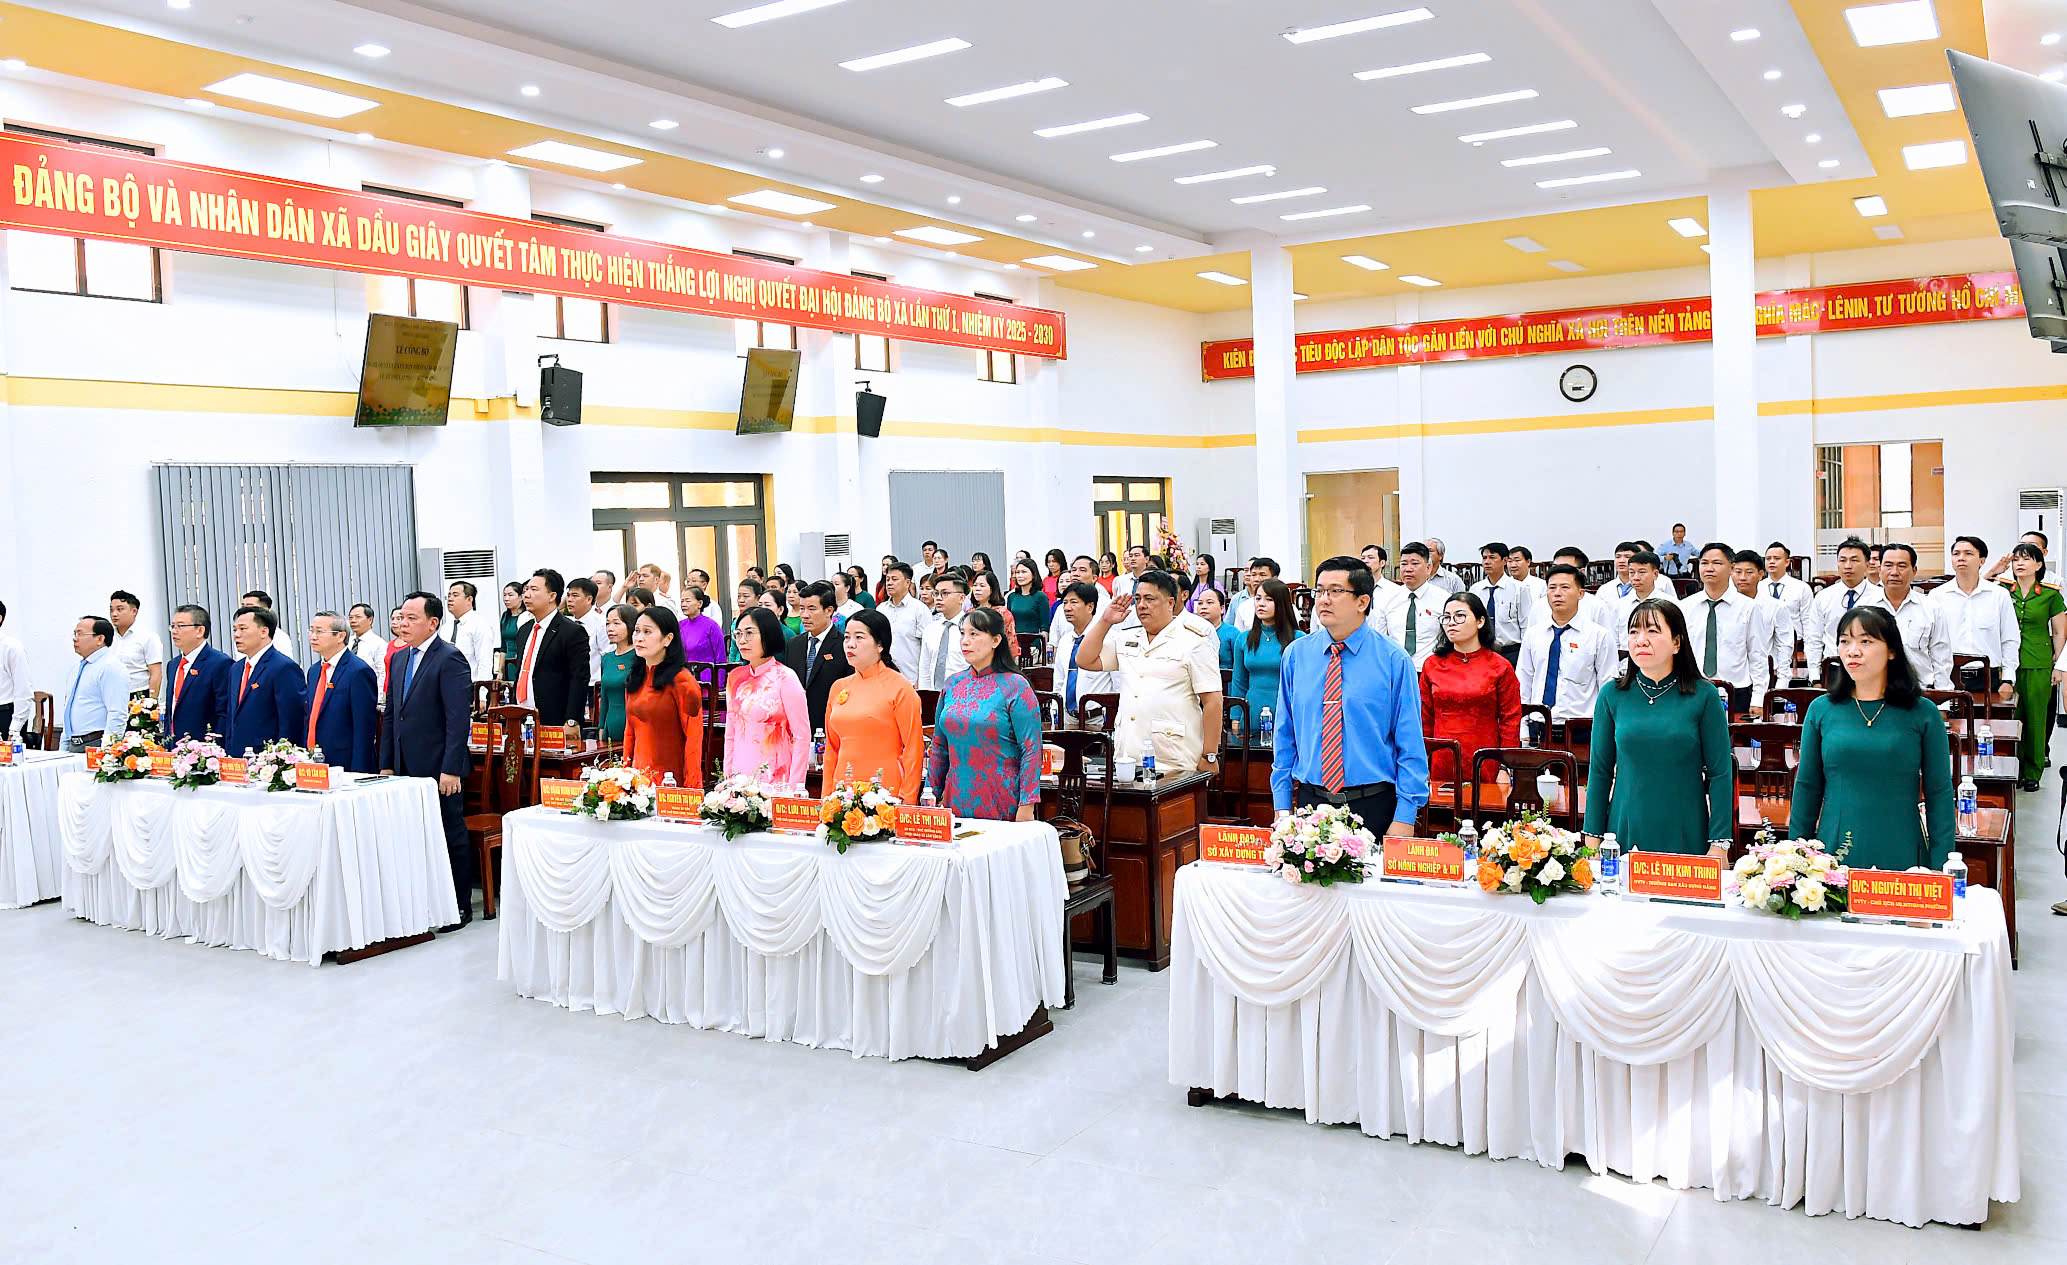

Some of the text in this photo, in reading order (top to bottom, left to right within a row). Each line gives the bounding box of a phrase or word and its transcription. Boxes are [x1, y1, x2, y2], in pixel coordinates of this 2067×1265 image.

[13, 155, 95, 214] ĐẢNG
[103, 172, 140, 228] BỘ
[147, 180, 183, 226] VÀ
[189, 189, 260, 236] NHÂN
[266, 198, 315, 244] DÂN
[321, 206, 351, 249] XÃ
[357, 208, 400, 255] DẦU
[406, 221, 451, 262] GIÂY
[457, 229, 514, 270] QUYẾT
[518, 237, 557, 277] TÂM
[561, 249, 603, 288] THỰC
[608, 252, 644, 293] HIỆN
[648, 254, 696, 296] THẮNG
[699, 269, 720, 304] LỢI
[724, 274, 756, 310] NGHỊ
[758, 275, 797, 310] QUYẾT
[799, 287, 820, 318] ĐẠI
[823, 286, 842, 321] HỘI
[844, 286, 875, 321] ĐẢNG
[877, 295, 892, 328] BỘ
[893, 298, 908, 326] XÃ
[910, 297, 930, 329] LẦN
[931, 303, 951, 332] THỨ
[962, 311, 992, 341] NHIỆM
[993, 312, 1005, 339] KỲ
[1006, 319, 1027, 342] 2025
[1034, 323, 1054, 346] 2030
[1755, 300, 1785, 326] GHĨA
[1789, 298, 1820, 323] MÁC
[1828, 297, 1873, 320] LÊNIN,
[1875, 294, 1896, 316] TƯ
[1898, 286, 1946, 314] TƯỞNG
[1951, 281, 1972, 310] HỒ
[1300, 341, 1323, 363] TIÊU
[1325, 339, 1346, 363] ĐỘC
[1348, 337, 1369, 361] LẬP
[1372, 335, 1395, 357] DÂN
[1398, 332, 1419, 358] TỘC
[1423, 327, 1447, 352] GẮN
[1450, 325, 1474, 350] LIỀN
[1478, 324, 1497, 348] VỚI
[1500, 320, 1524, 346] CHỦ
[1527, 320, 1564, 344] NGHĨA
[1567, 318, 1585, 340] XÃ
[1648, 310, 1675, 334] NỀN
[1677, 306, 1711, 332] TẢNG
[1223, 348, 1246, 369] KIÊN
[913, 812, 920, 825] LÊ
[921, 814, 931, 827] THỊ
[1218, 831, 1256, 844] LÃNH ĐẠO
[1207, 844, 1218, 857] SỞ
[1219, 846, 1234, 858] XÂY
[1235, 848, 1257, 860] DỰNG
[1407, 843, 1439, 858] LÃNH ĐẠO
[1388, 857, 1397, 870] SỞ
[1398, 859, 1417, 872] NÔNG
[1417, 860, 1441, 876] NGHIỆP
[1442, 863, 1448, 874] &
[1633, 860, 1718, 880] Đ/C: LÊ THỊ KIM TRINH
[1852, 878, 1943, 901] Đ/C: NGUYỄN THỊ VIỆT
